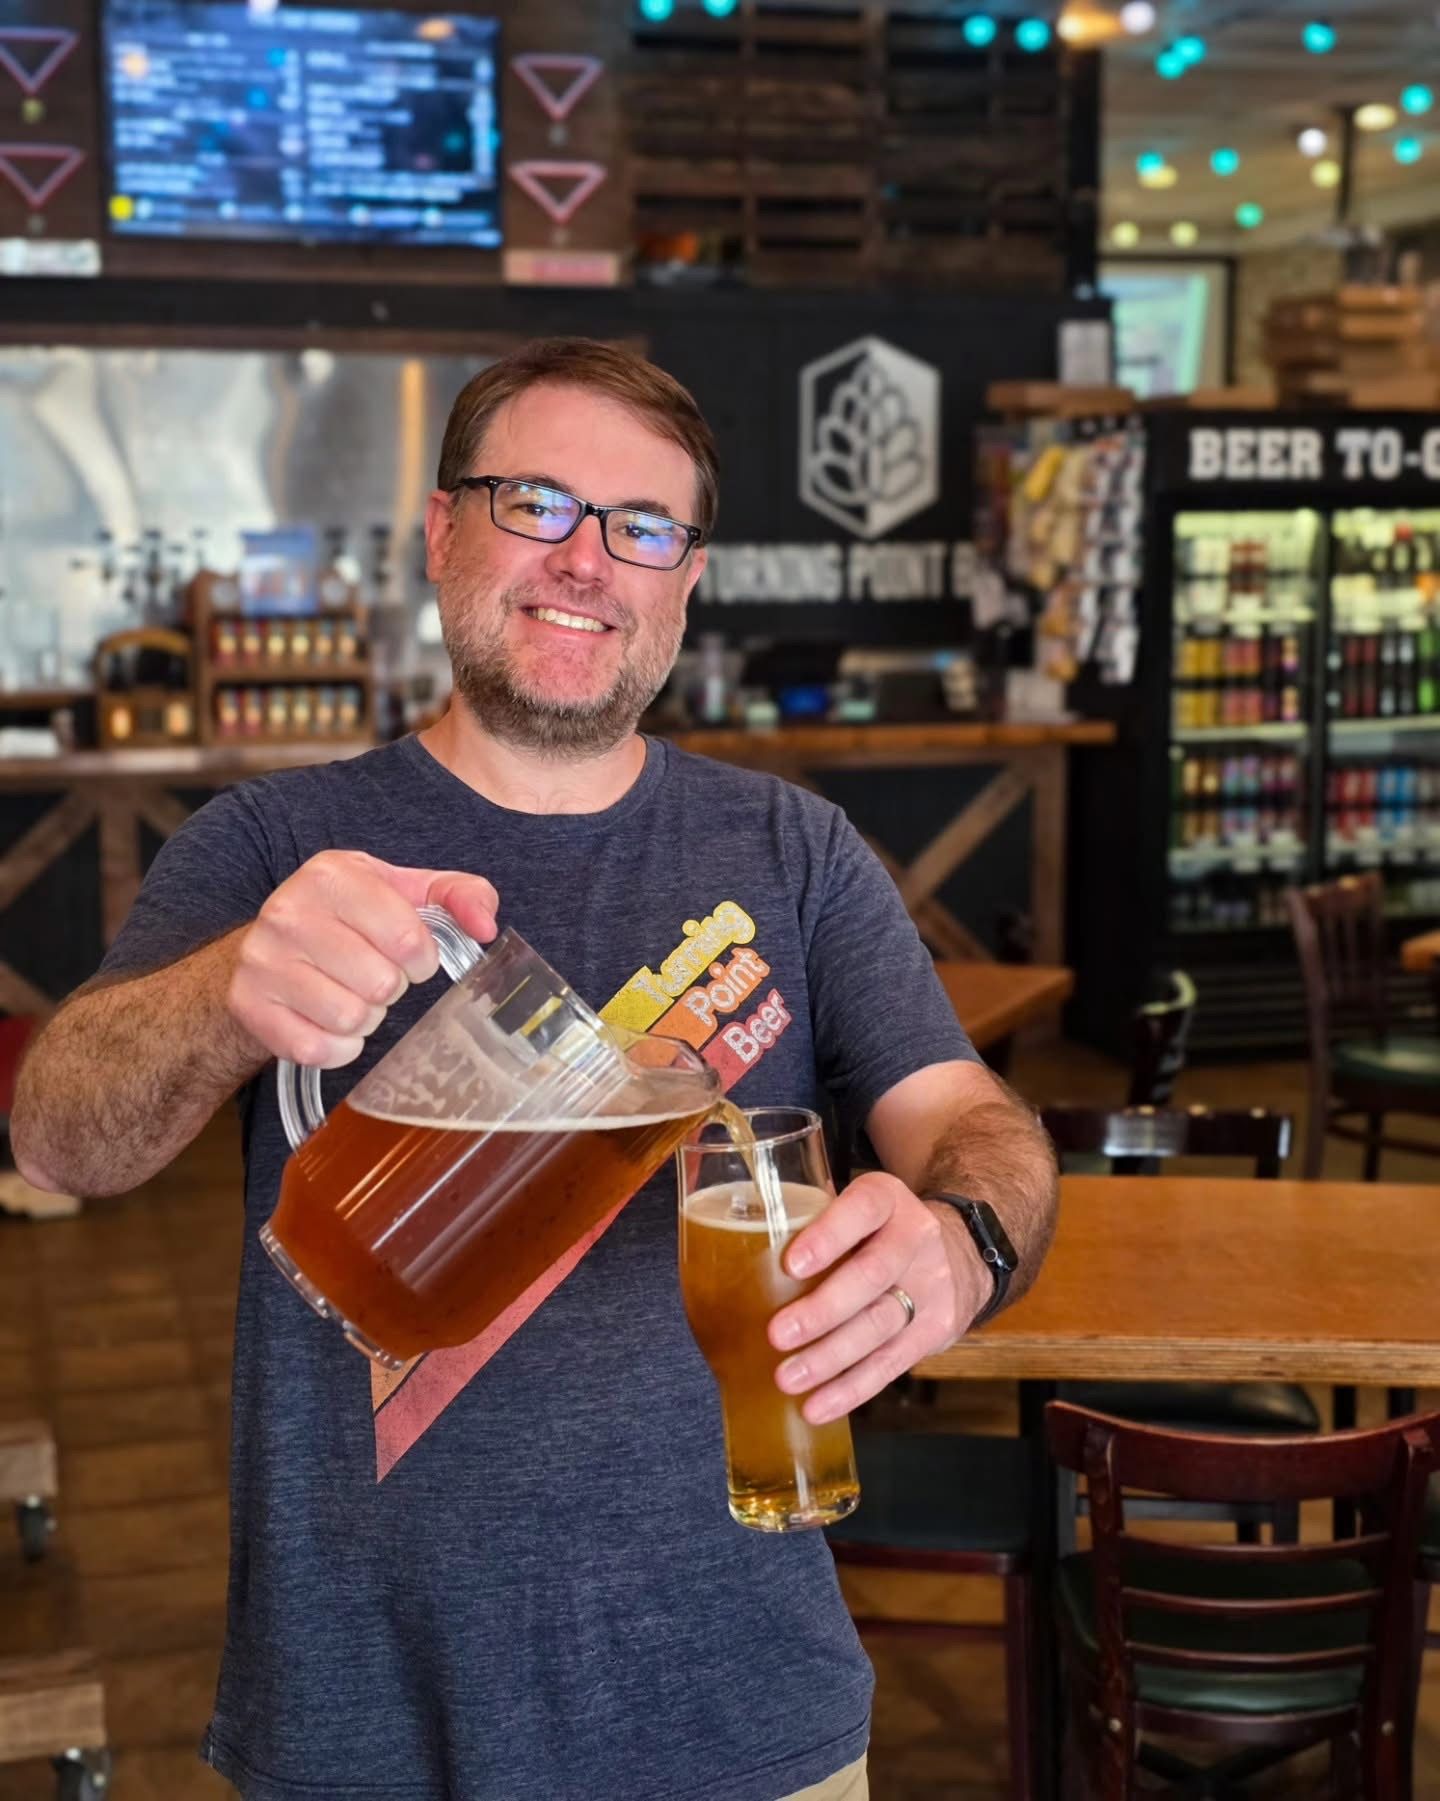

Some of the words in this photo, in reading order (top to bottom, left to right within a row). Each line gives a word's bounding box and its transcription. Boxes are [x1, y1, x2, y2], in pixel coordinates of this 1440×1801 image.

[1189, 428, 1322, 480] BEER
[850, 543, 945, 600] POINT
[633, 907, 753, 1004] Turning
[686, 951, 766, 1027] Point
[722, 993, 790, 1065] Beer
